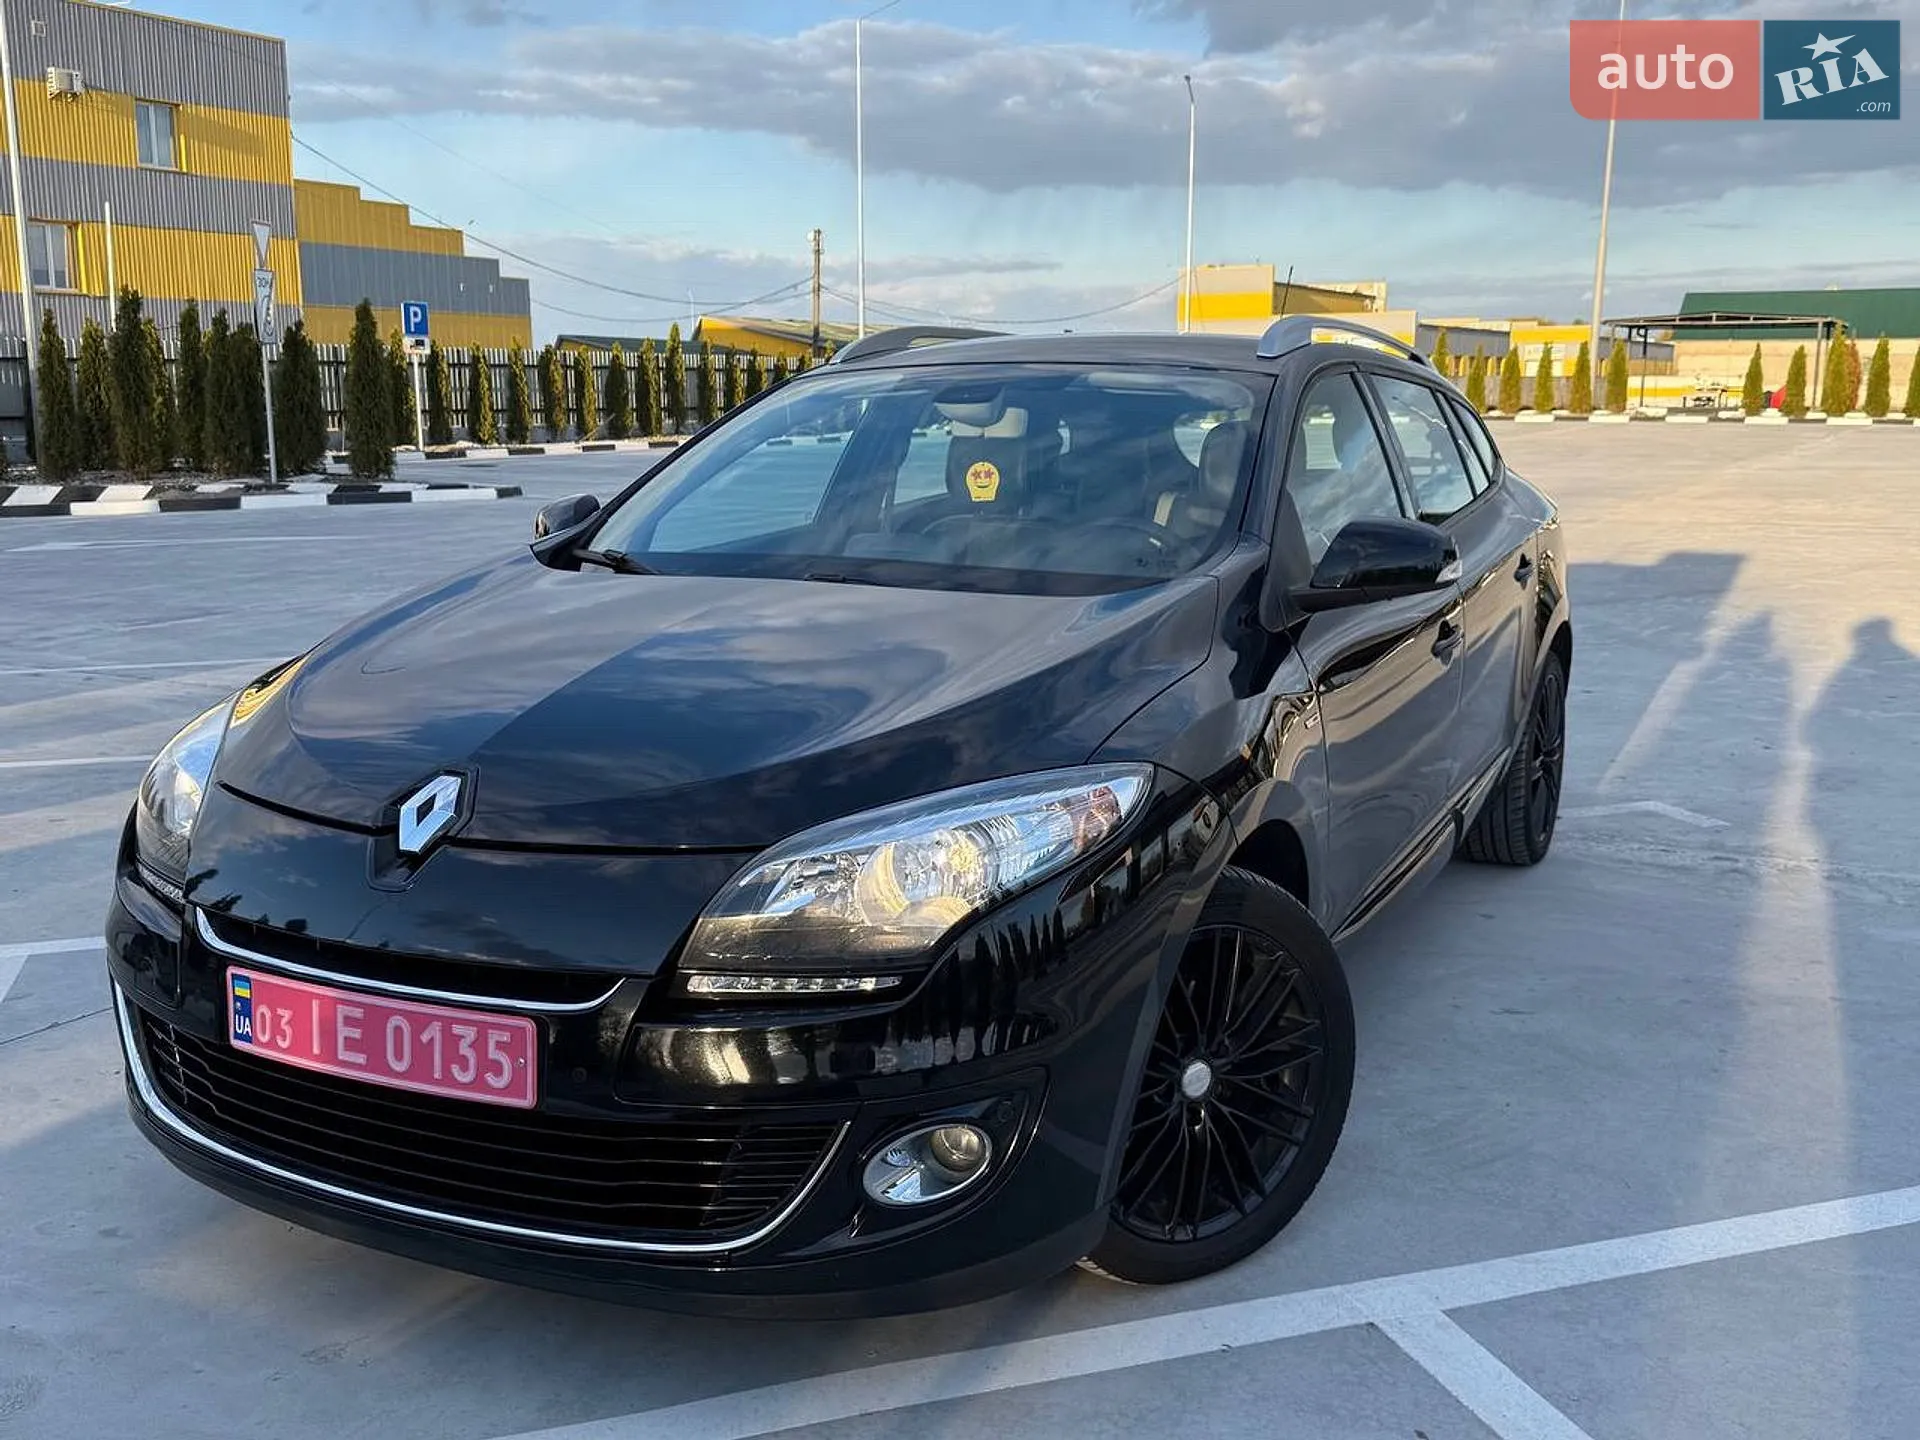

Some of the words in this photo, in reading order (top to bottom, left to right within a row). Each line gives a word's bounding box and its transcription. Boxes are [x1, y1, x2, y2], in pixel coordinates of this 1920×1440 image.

[409, 305, 422, 333] P
[235, 1014, 252, 1037] UA
[256, 1004, 294, 1050] 03
[311, 999, 368, 1066] IE
[386, 1015, 513, 1090] 0135
